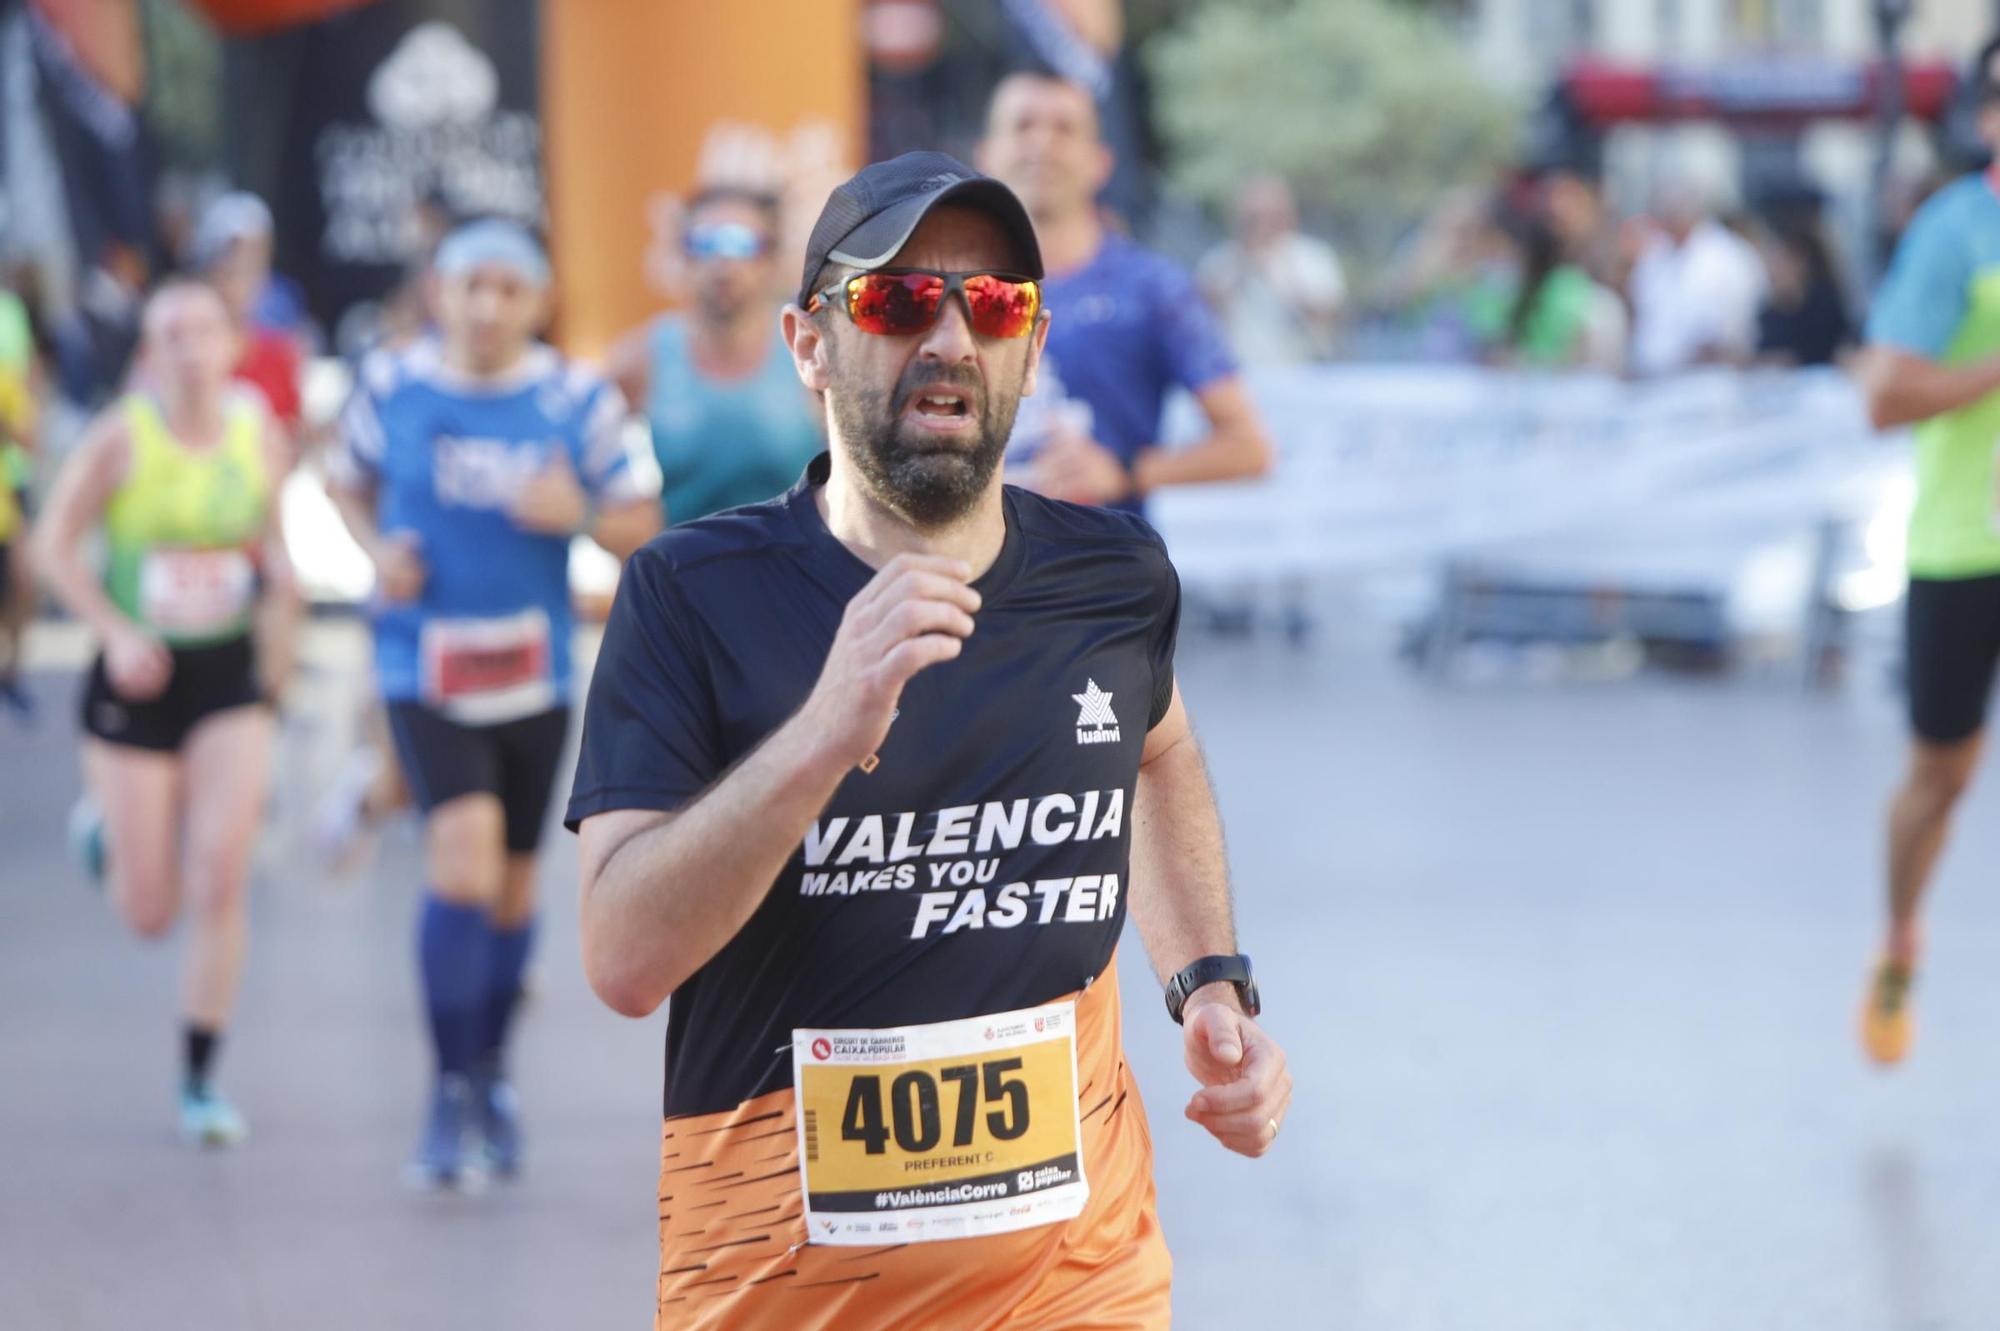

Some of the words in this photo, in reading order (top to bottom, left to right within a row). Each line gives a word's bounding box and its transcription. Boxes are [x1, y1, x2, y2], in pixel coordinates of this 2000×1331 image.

[1077, 726, 1120, 744] luanvi
[803, 788, 1124, 866] VALENCIA
[800, 864, 916, 895] MAKES
[929, 858, 999, 887] YOU
[911, 873, 1119, 939] FASTER
[834, 1045, 866, 1054] CAIXA
[868, 1044, 905, 1054] POPULAR
[841, 1056, 1030, 1155] 4075
[904, 1154, 980, 1171] PREFERENT
[985, 1152, 994, 1162] C
[1034, 1166, 1058, 1178] caixa
[1034, 1169, 1072, 1188] popular
